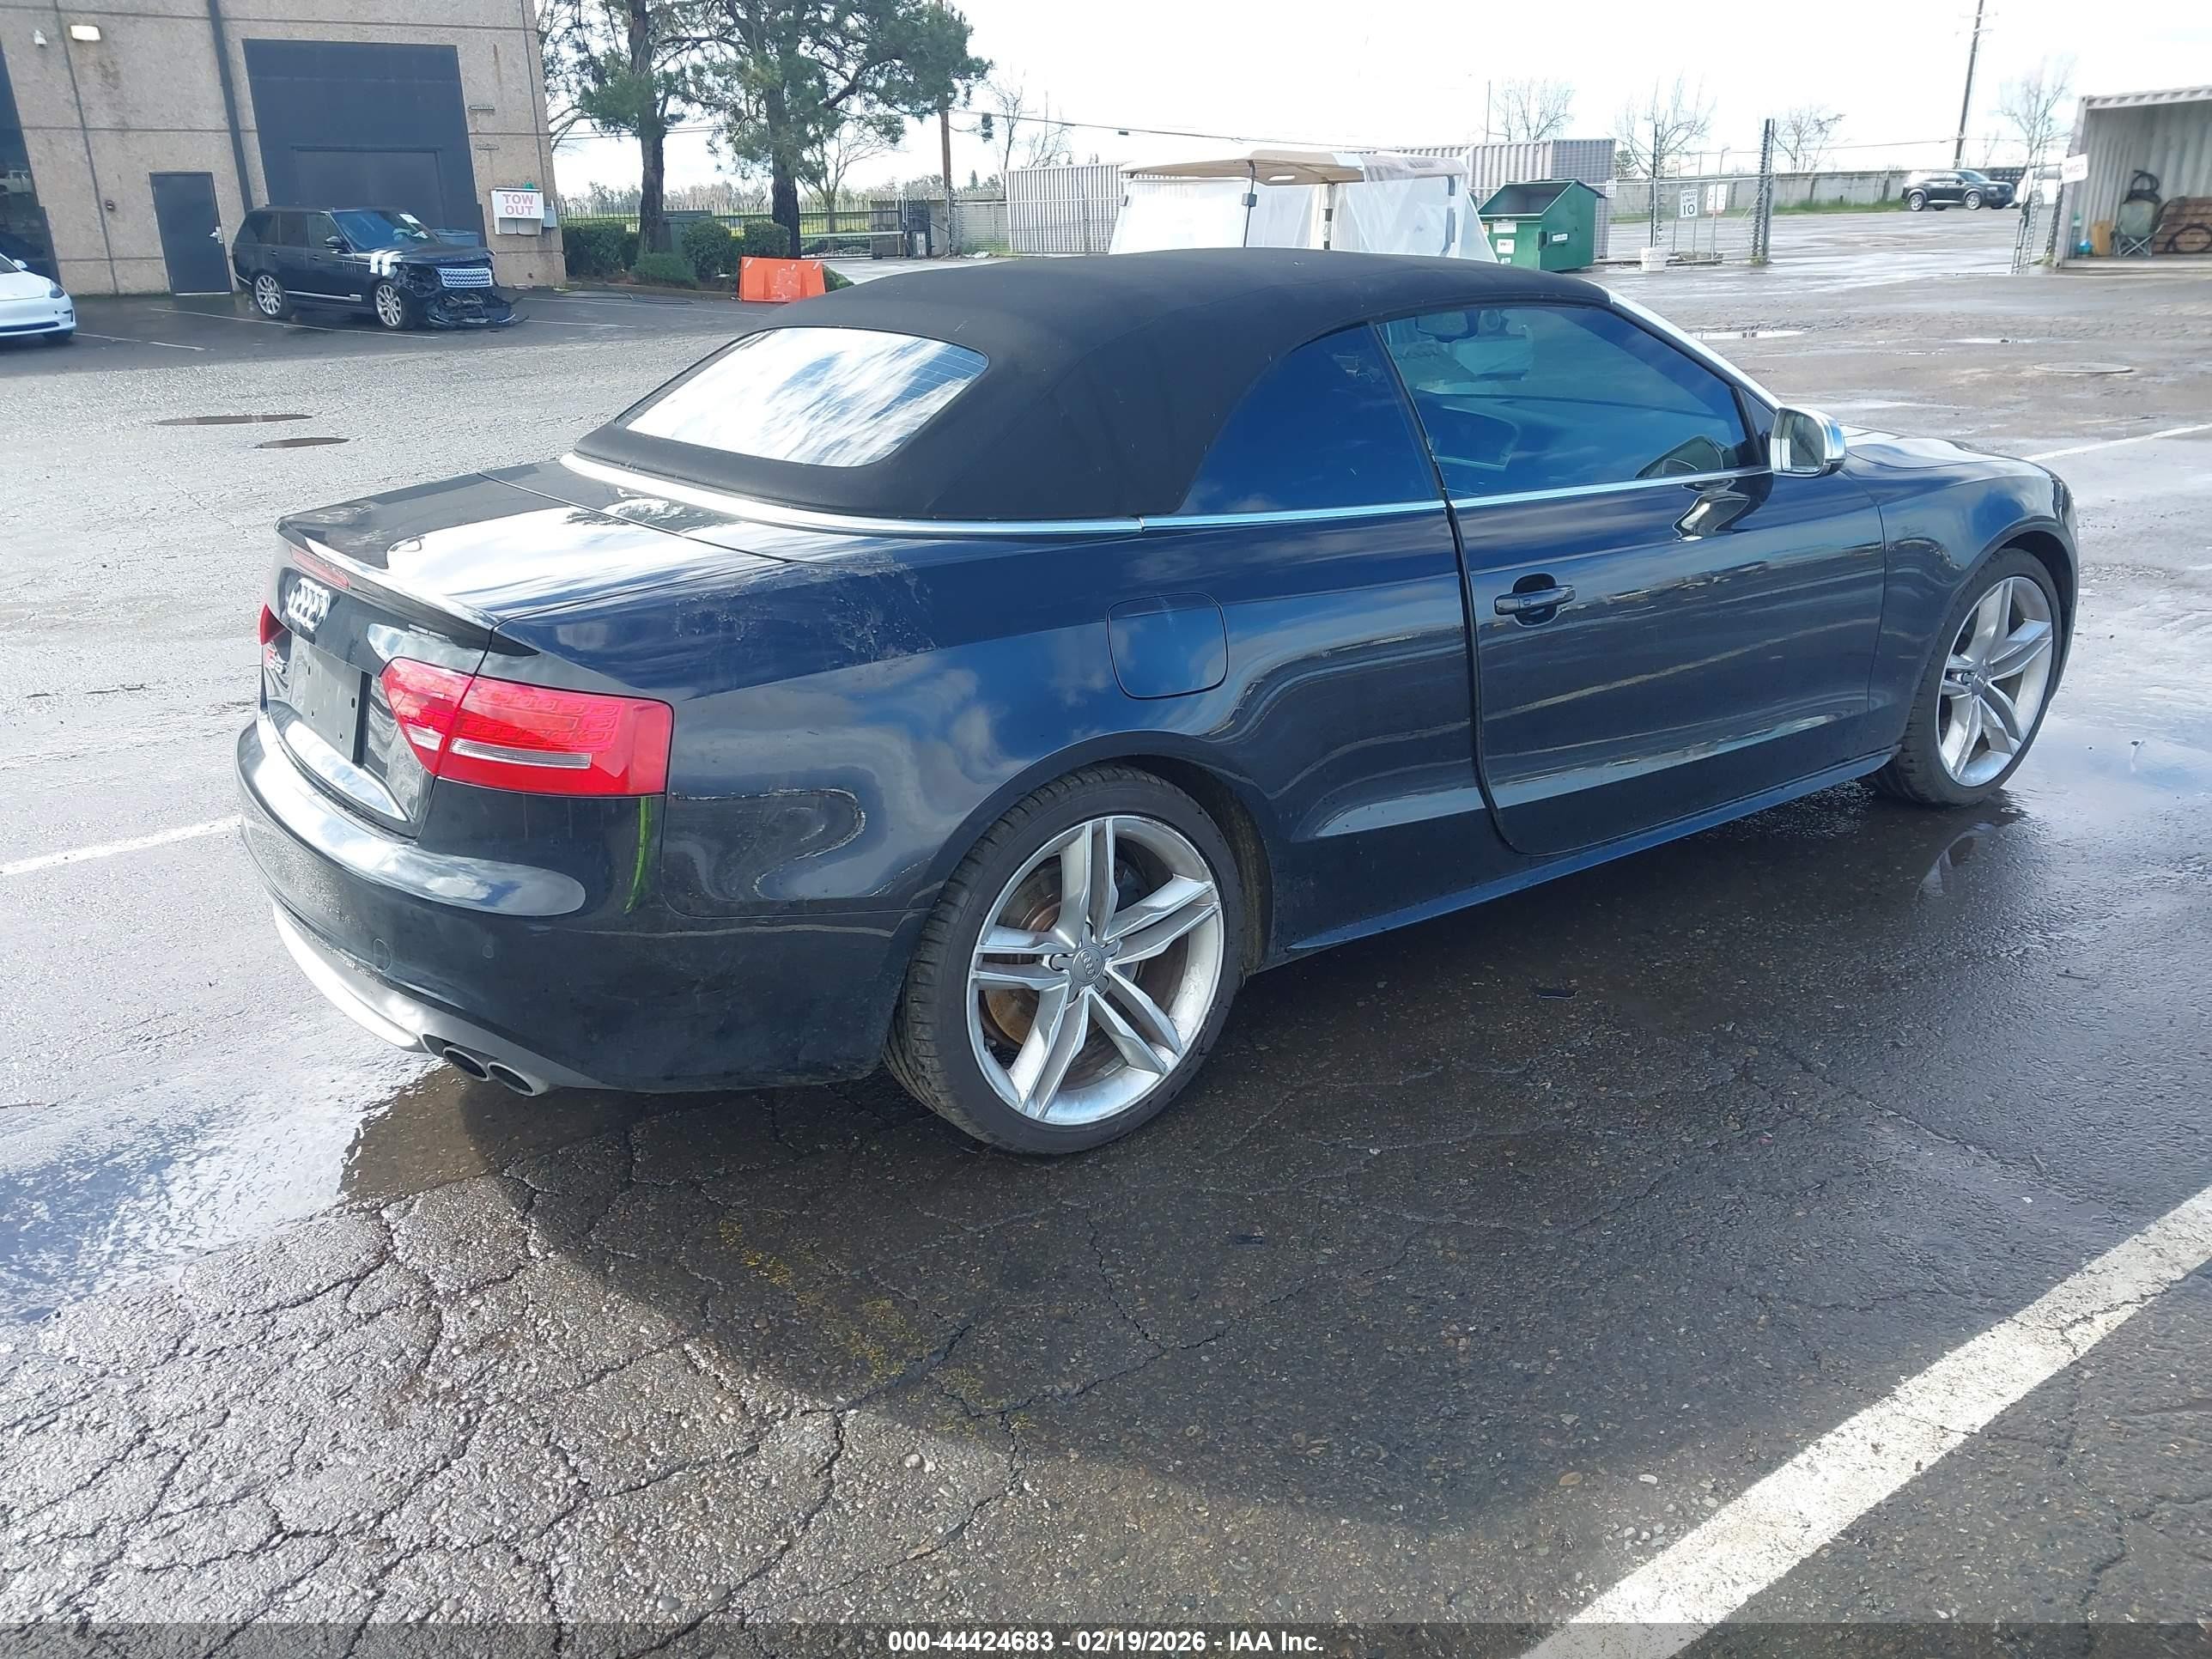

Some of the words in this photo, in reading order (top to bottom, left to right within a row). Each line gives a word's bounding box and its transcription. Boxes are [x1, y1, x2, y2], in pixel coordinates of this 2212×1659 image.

[502, 194, 533, 204] TOW
[505, 205, 533, 215] OUT
[1683, 204, 1695, 215] 10
